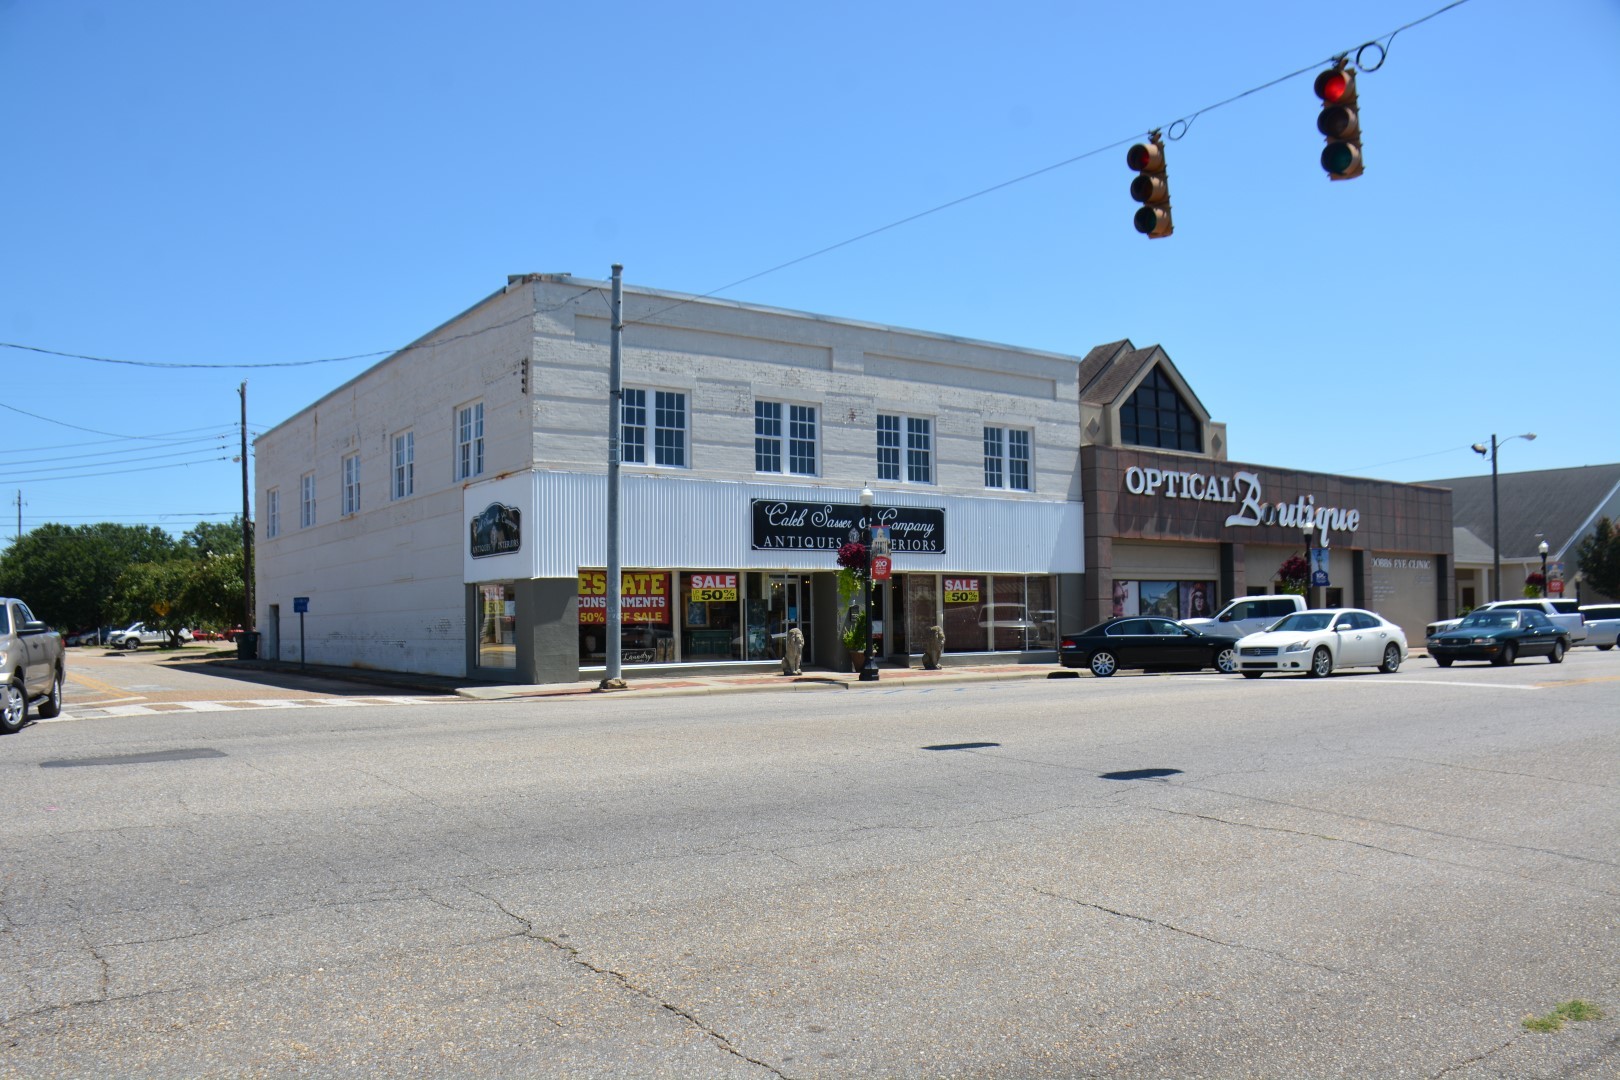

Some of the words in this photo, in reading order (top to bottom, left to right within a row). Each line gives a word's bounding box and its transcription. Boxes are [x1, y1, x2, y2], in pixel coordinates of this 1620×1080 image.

[1126, 466, 1236, 503] OPTICAL
[1225, 471, 1360, 548] Boutique
[765, 502, 808, 527] Caleb
[811, 504, 852, 528] Sasser
[877, 508, 935, 538] Company
[764, 535, 842, 549] ANTIQUES
[891, 538, 936, 551] ERIORS
[578, 573, 664, 595] ESATE
[692, 575, 736, 588] SALE
[945, 579, 978, 590] SALE
[701, 589, 735, 600] 50%
[952, 591, 977, 601] 50%
[578, 596, 665, 607] CONSNMENTS
[580, 612, 605, 622] 50%
[633, 612, 662, 621] SALE
